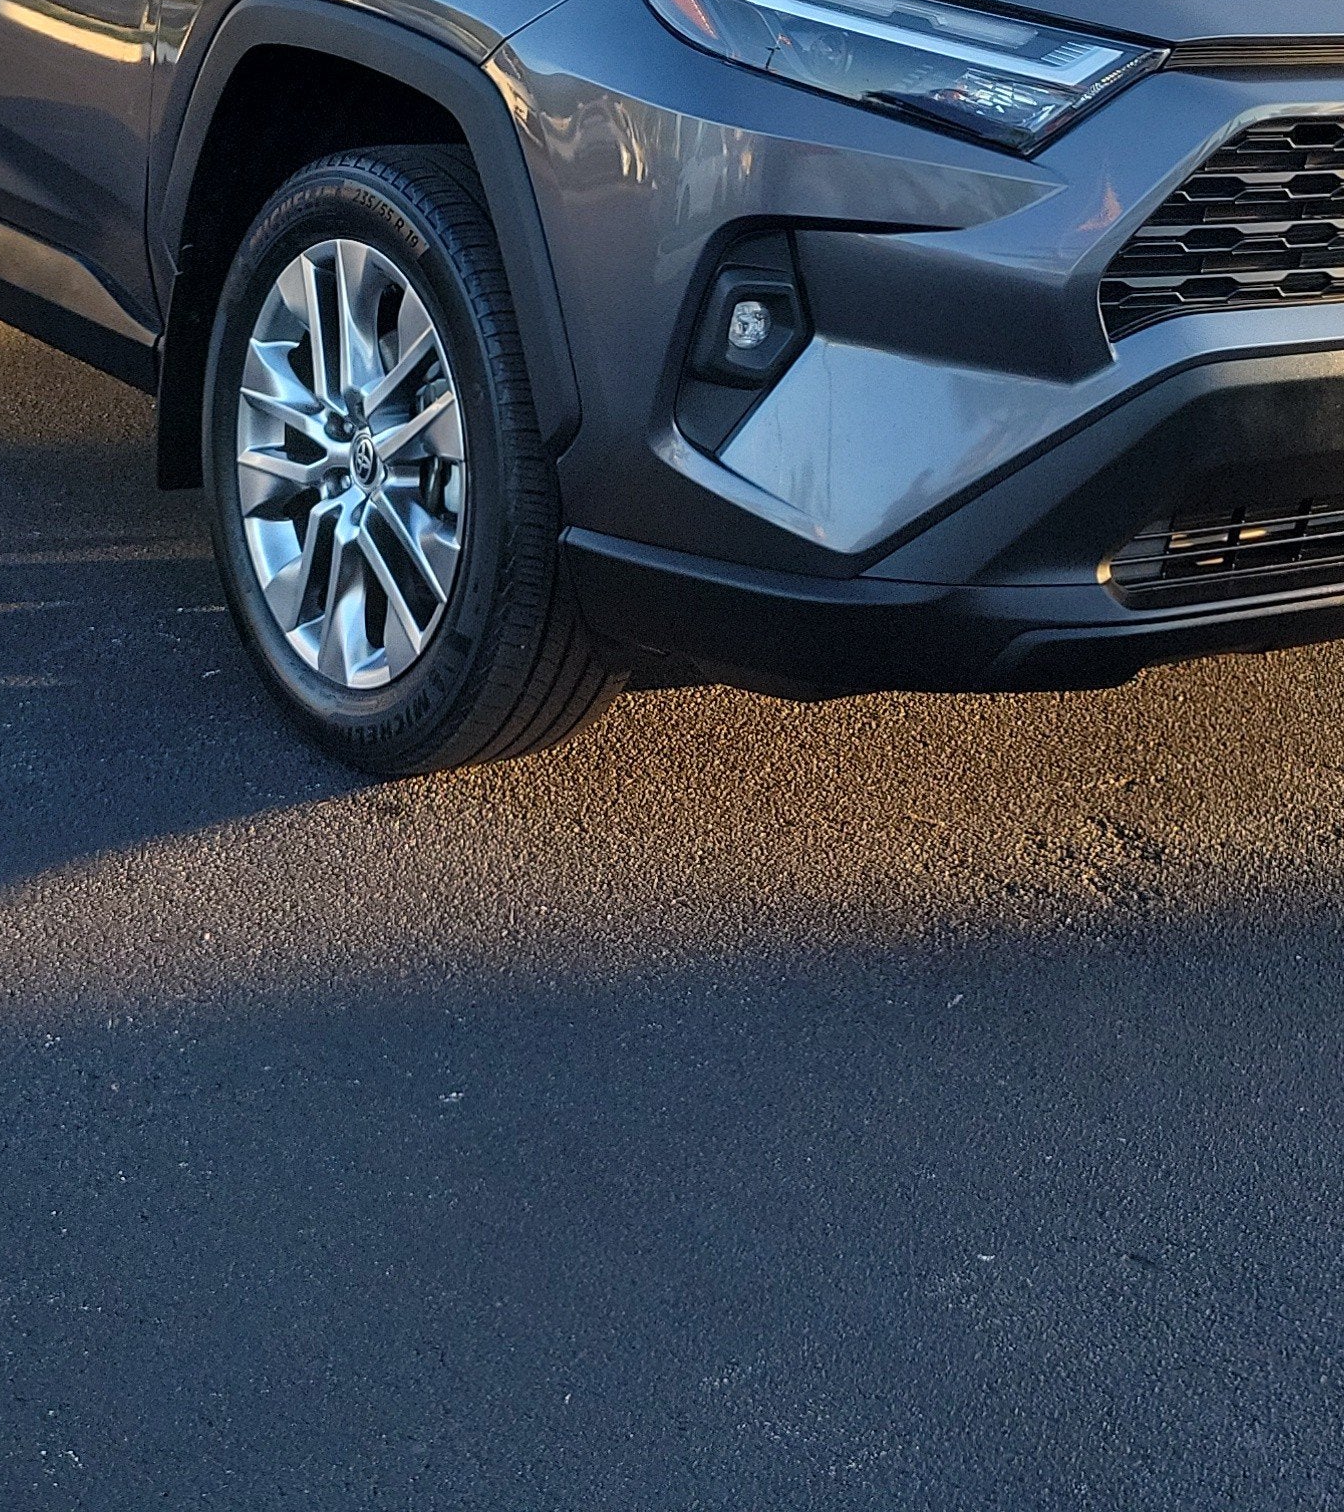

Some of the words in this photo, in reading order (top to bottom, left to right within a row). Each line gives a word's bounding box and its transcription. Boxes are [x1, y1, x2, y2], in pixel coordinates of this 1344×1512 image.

[353, 188, 393, 222] 235/55
[394, 217, 405, 233] R
[405, 230, 419, 248] 19
